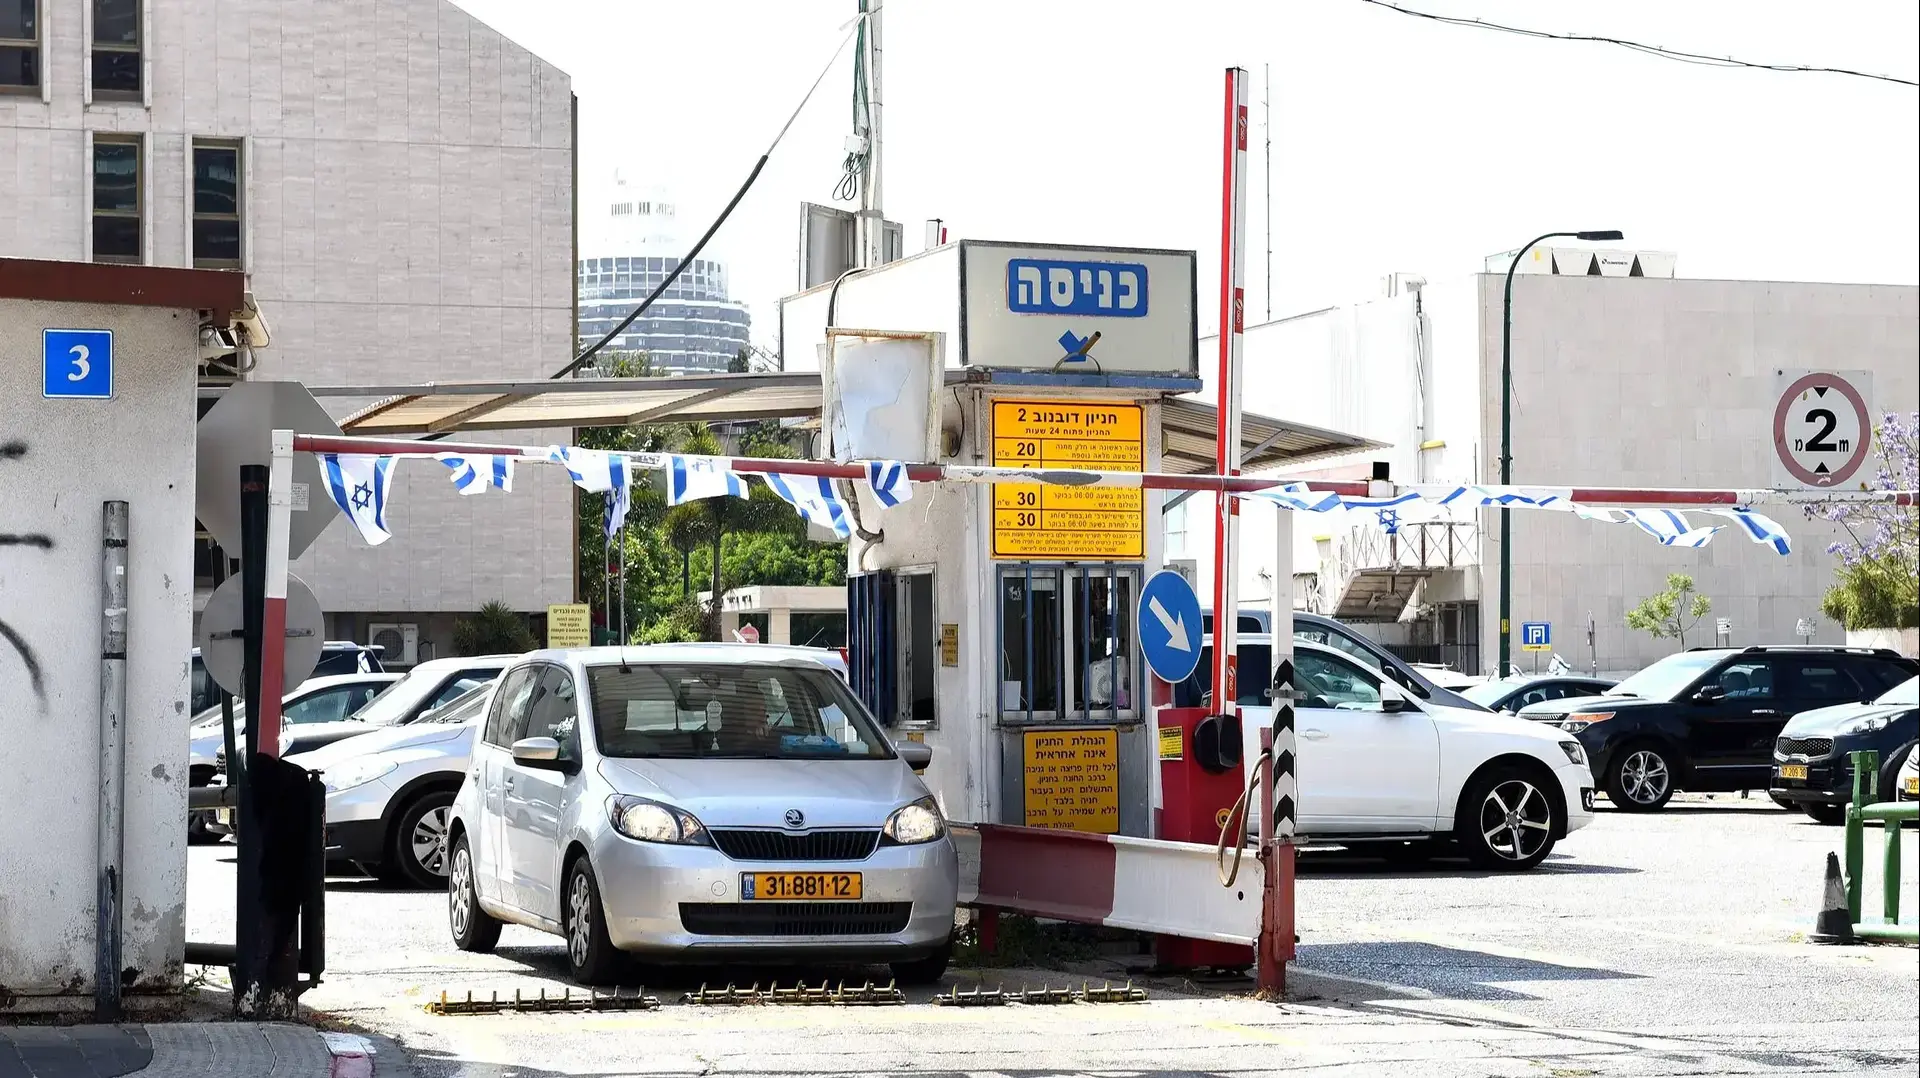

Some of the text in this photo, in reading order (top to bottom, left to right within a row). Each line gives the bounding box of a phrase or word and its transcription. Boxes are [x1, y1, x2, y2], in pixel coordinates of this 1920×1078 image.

[1018, 266, 1139, 309] כניסה
[68, 344, 90, 381] 3
[1018, 408, 1118, 426] חניון דובנוב 2
[1063, 428, 1083, 436] פתוח
[1805, 408, 1837, 452] 2
[1017, 442, 1036, 456] 20
[1018, 492, 1036, 506] 30
[1018, 512, 1036, 526] 30
[1036, 736, 1106, 748] הנהלת החניון
[1036, 749, 1106, 760] אינה אחראית
[1086, 764, 1099, 772] נזק
[1102, 762, 1116, 770] לכל
[1060, 786, 1074, 794] הינו
[1080, 784, 1112, 793] התשלום
[1054, 796, 1074, 804] בלבד
[1027, 806, 1116, 817] ללא שמירה על הרכב
